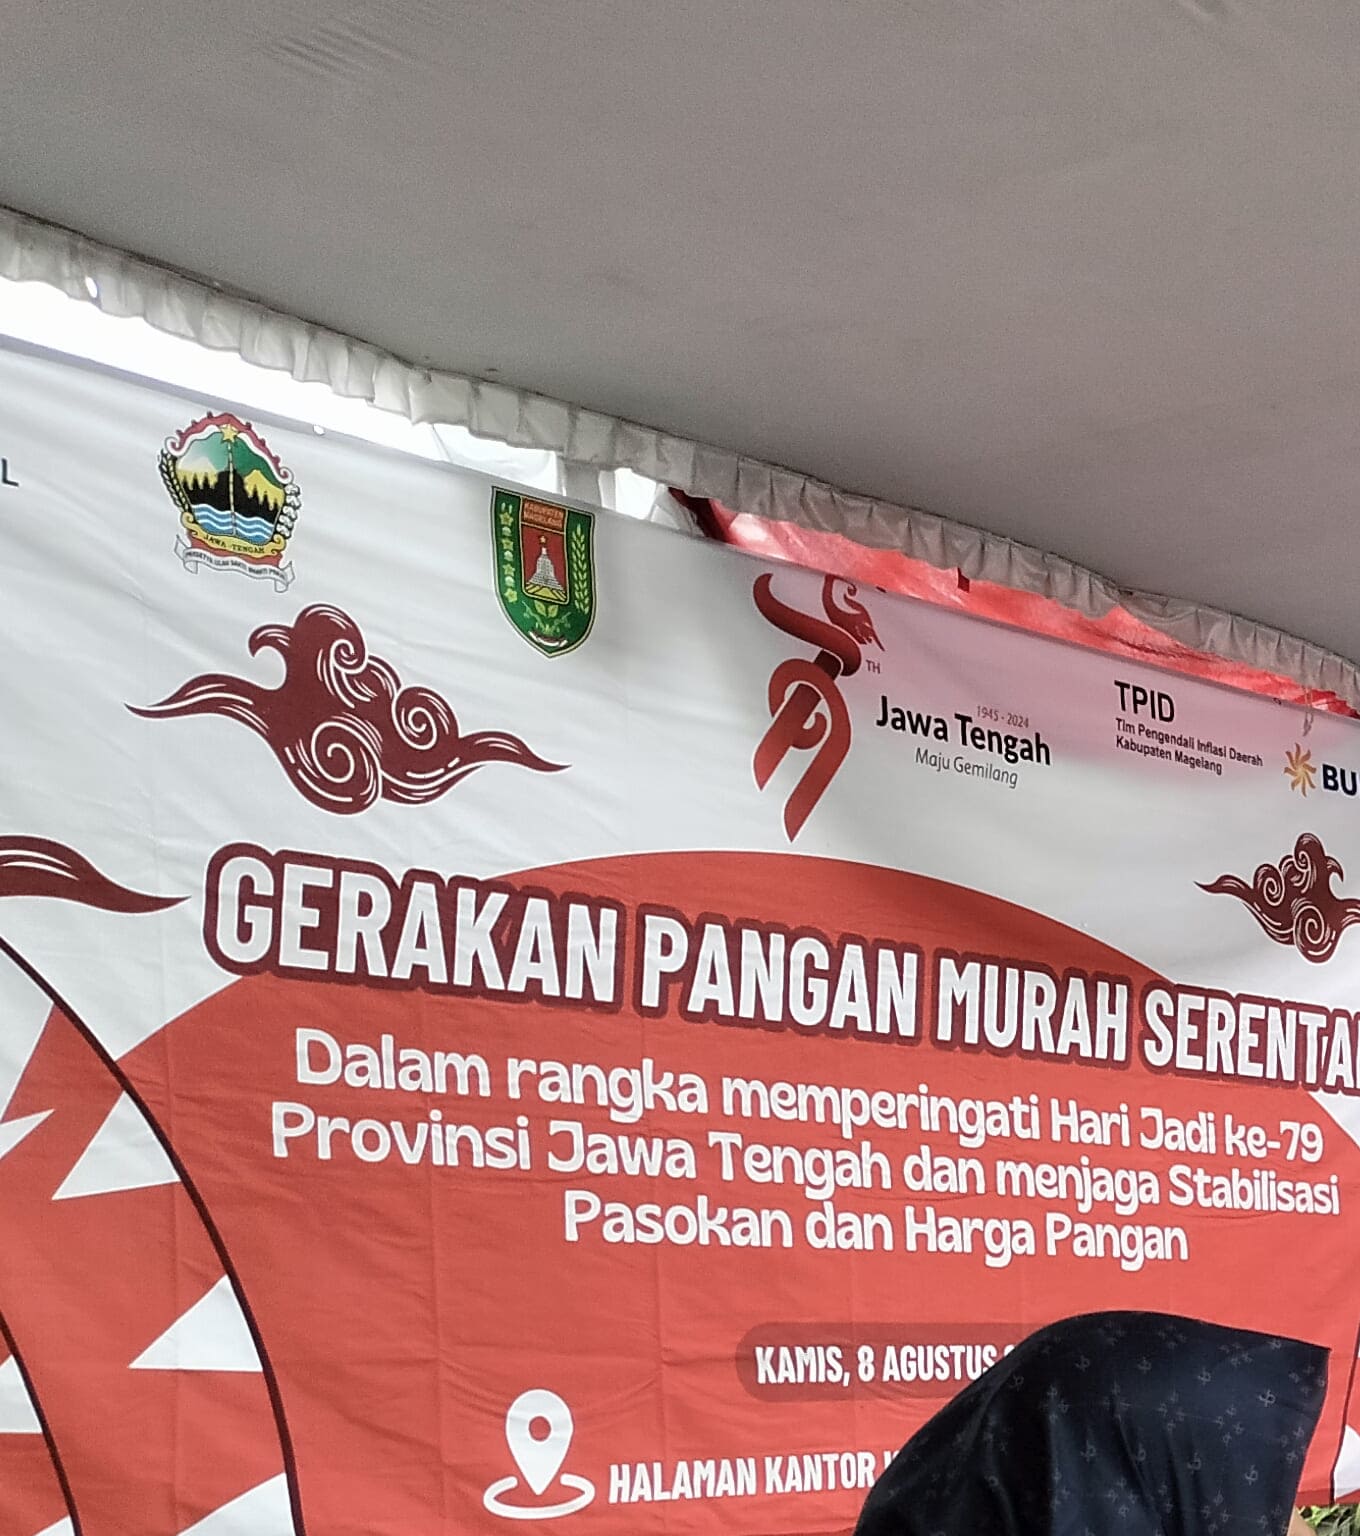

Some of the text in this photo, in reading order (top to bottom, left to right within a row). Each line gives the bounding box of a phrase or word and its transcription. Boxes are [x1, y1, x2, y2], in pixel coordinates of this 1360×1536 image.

[866, 660, 881, 674] TH
[977, 705, 1000, 722] 1945
[1007, 712, 1029, 729] 2024
[1114, 679, 1175, 723] TPID
[876, 695, 1051, 766] Jawa Tengah
[1115, 717, 1263, 767] Tim Pengendali Inflasi Daerah
[1116, 735, 1223, 776] Kabupaten Magelang
[915, 747, 1018, 790] Maju Gemilang
[215, 855, 618, 1003] GERAKAN
[641, 913, 917, 1037] PANGAN
[936, 956, 1128, 1061] MURAH
[296, 1027, 1324, 1163] Dalam rangka memperingati Hari Jadi ke-79
[271, 1101, 1341, 1216] Provinsi Jawa Tengah dan menjaga Stabilisasi
[565, 1190, 1190, 1271] Pasokan dan Harga Pangan
[755, 1344, 997, 1387] KAMIS, 8 AGUSTUS
[609, 1458, 756, 1504] HALAMAN
[765, 1452, 876, 1495] KANTOR
